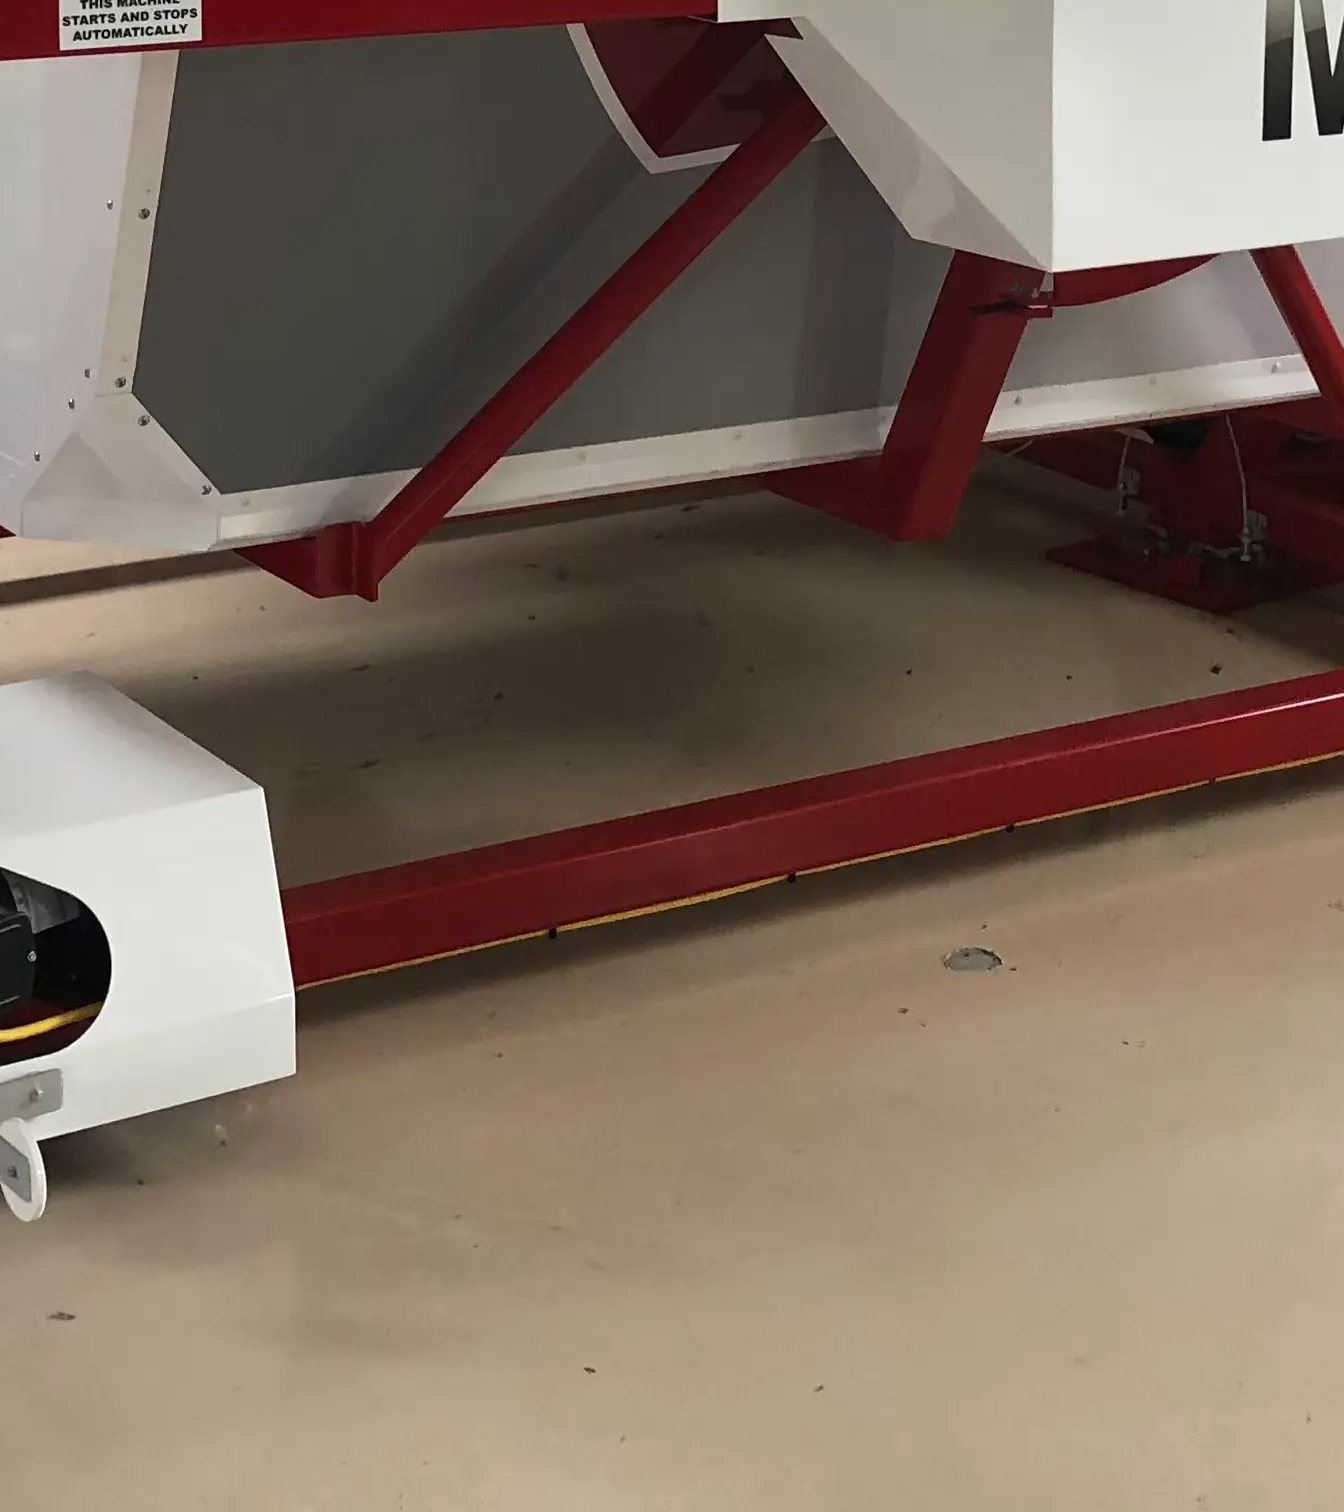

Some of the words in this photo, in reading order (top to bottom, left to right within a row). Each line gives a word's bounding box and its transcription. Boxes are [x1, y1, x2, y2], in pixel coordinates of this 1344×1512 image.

[80, 0, 113, 10] THIS
[62, 13, 116, 27] STARTS
[120, 11, 150, 22] AND
[153, 7, 198, 20] STOPS
[72, 23, 189, 42] AUTOMATICALLY
